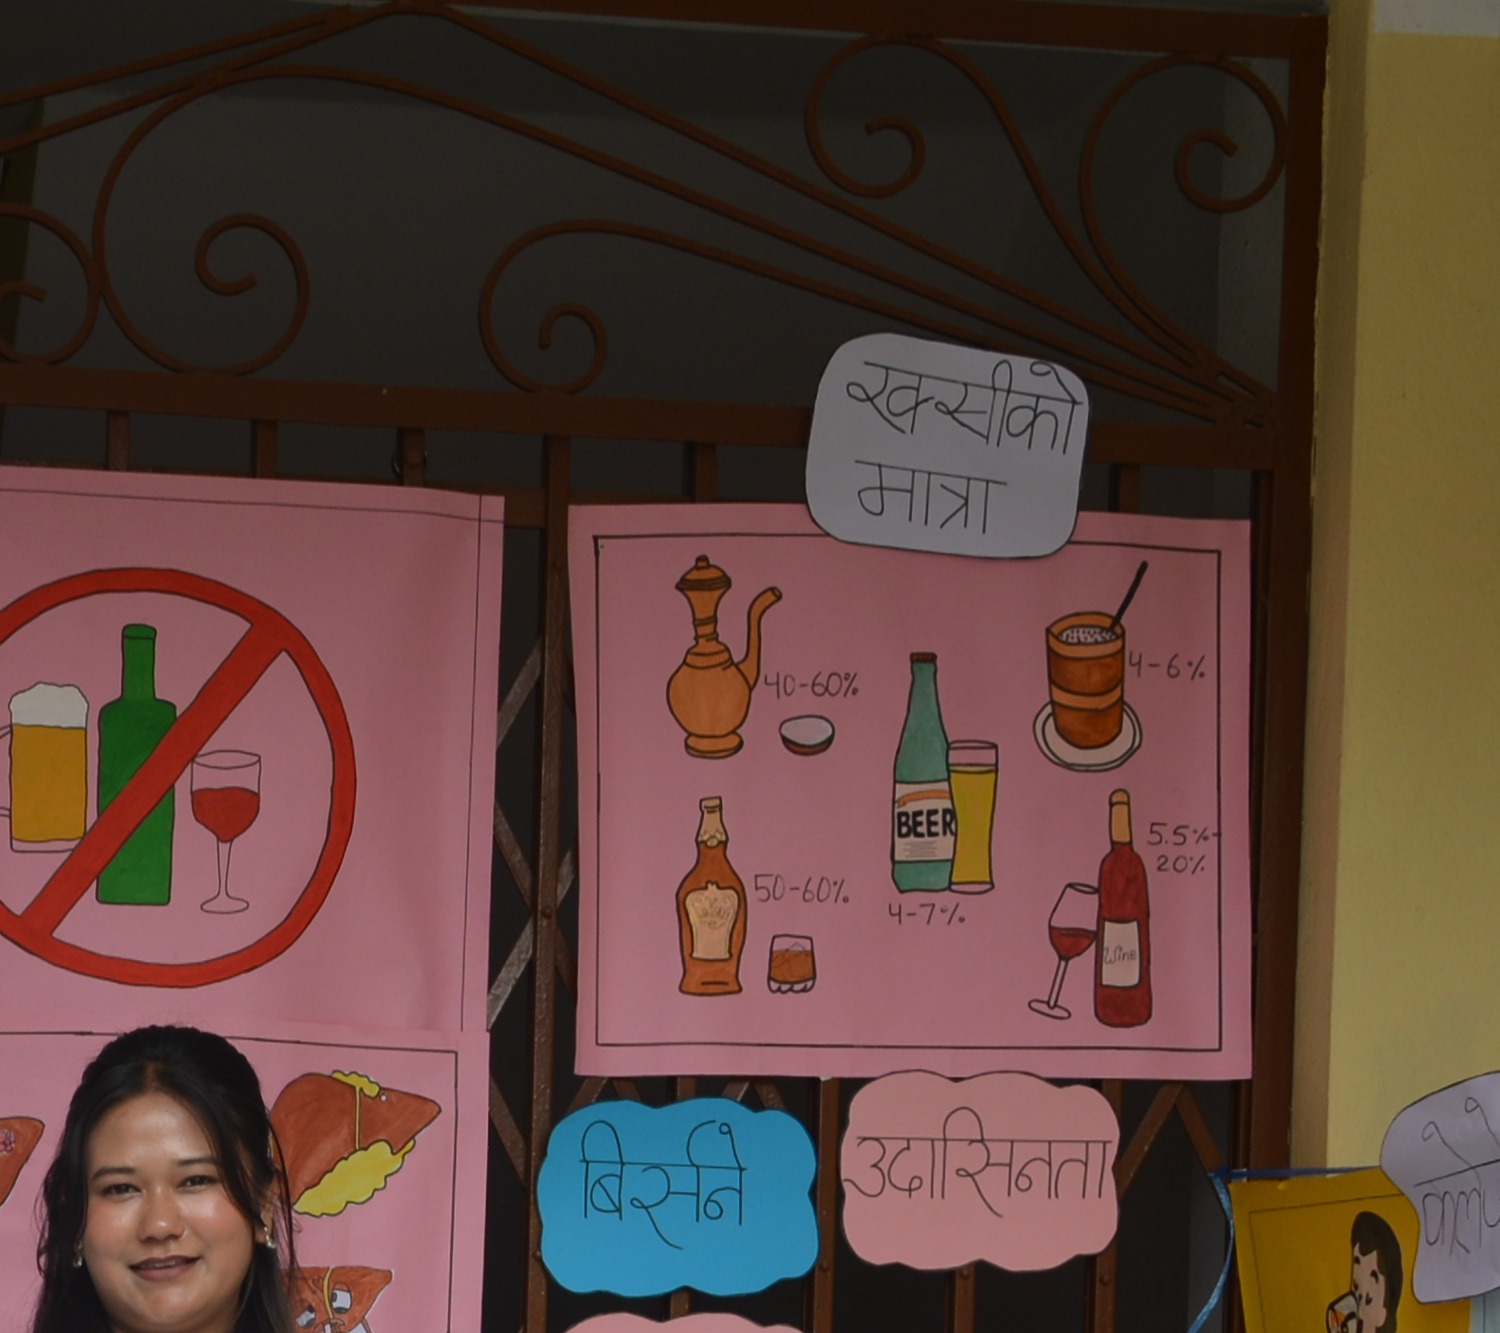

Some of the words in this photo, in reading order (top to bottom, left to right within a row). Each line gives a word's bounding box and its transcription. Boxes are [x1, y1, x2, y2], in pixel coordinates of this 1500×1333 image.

[854, 459, 1009, 535] मात्रा
[764, 671, 859, 700] 40-60%
[895, 807, 957, 839] BEER
[1155, 853, 1207, 876] 20%
[753, 873, 850, 904] 50-60%
[887, 901, 967, 926] 4-7%
[1102, 944, 1138, 968] Wine
